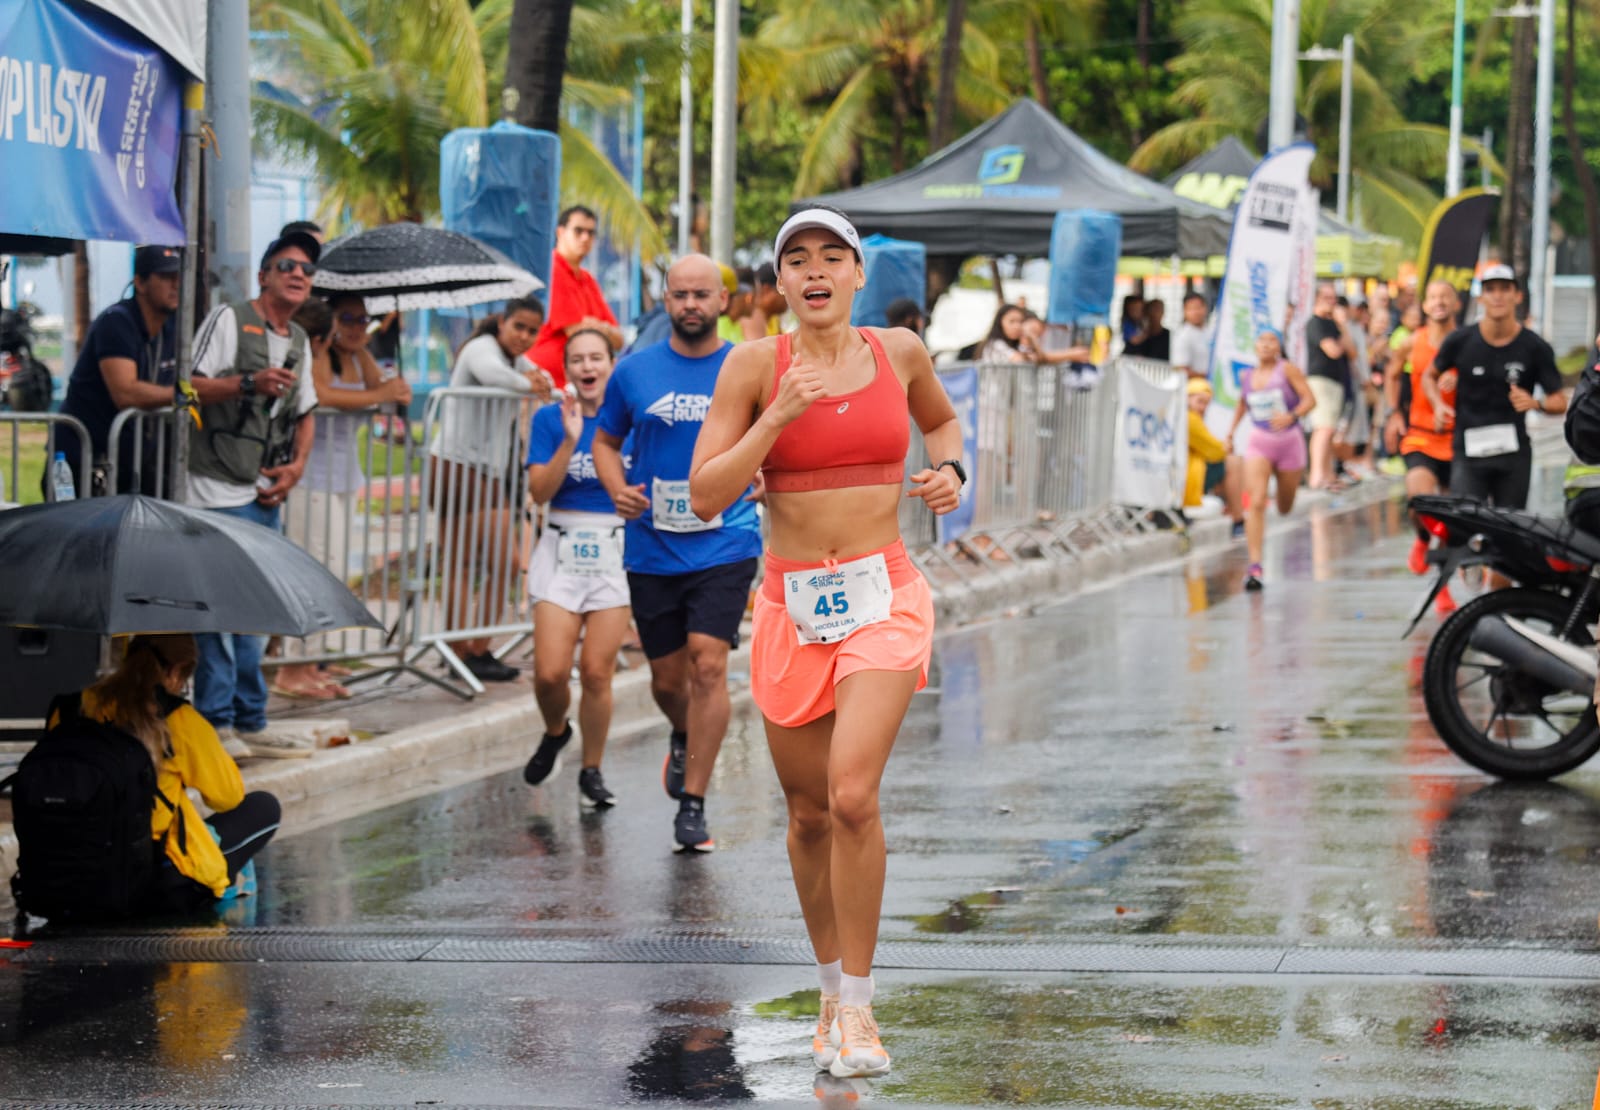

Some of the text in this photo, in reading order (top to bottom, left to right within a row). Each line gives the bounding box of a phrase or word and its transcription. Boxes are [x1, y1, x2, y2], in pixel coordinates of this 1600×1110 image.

[674, 407, 706, 422] RUN
[664, 498, 692, 514] 78
[573, 543, 600, 558] 163
[817, 571, 846, 581] CESMAC
[814, 591, 849, 617] 45
[815, 622, 840, 631] NICOLE
